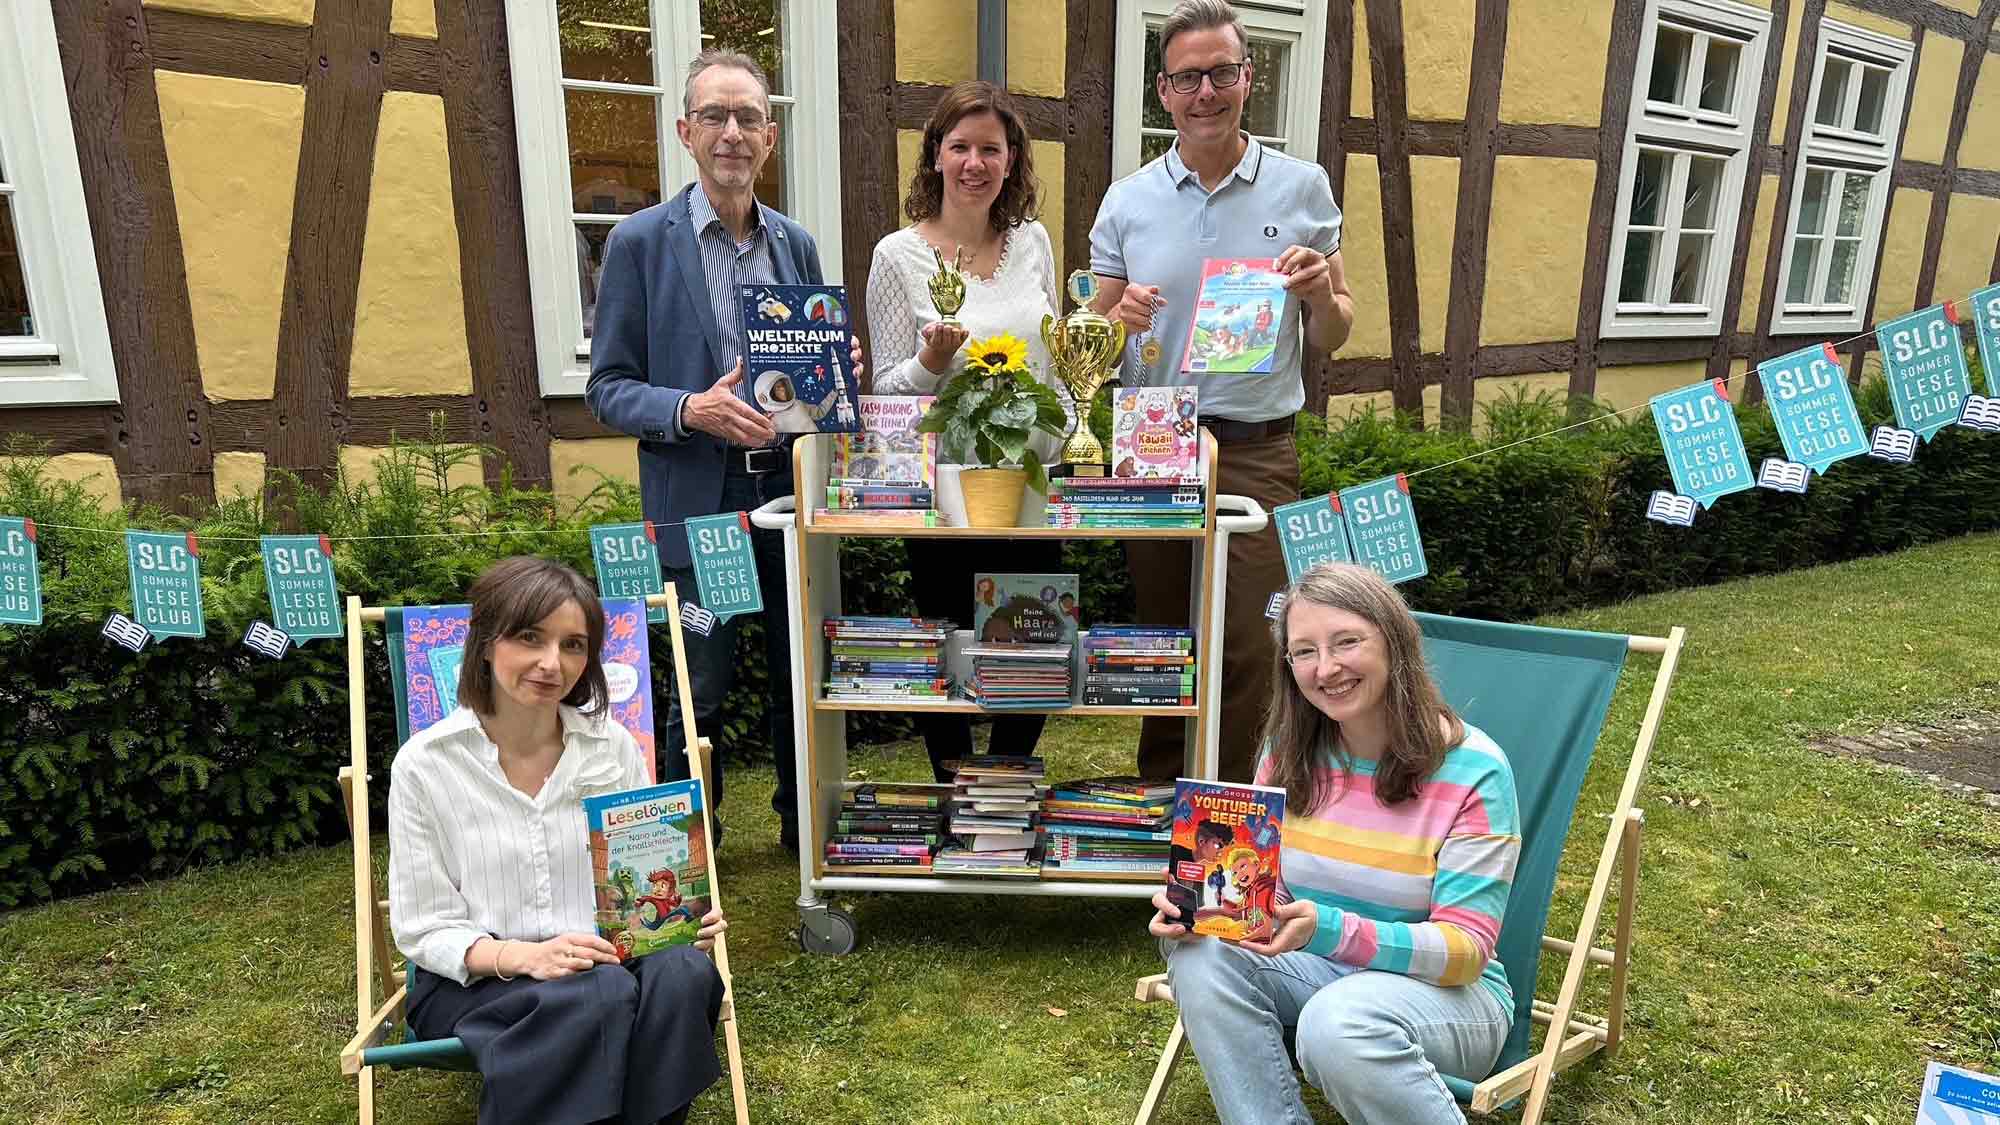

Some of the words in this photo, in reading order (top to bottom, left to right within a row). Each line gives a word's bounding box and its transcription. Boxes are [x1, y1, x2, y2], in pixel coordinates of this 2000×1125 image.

[747, 329, 845, 342] WELTRAUM
[1893, 319, 1948, 363] SLC
[750, 343, 823, 354] PROJEKTE
[1901, 354, 1951, 380] SOMMER
[1775, 359, 1832, 400] SLC
[1904, 369, 1956, 401] LESE
[860, 403, 880, 415] EASY
[1666, 394, 1721, 433] SLC
[1787, 392, 1838, 417] SOMMER
[1909, 391, 1960, 422] CLUB
[1792, 407, 1847, 436] LESE
[1138, 432, 1173, 444] Kawaii
[1676, 427, 1726, 449] SOMMER
[1799, 427, 1851, 457] CLUB
[1682, 441, 1732, 469] LESE
[1687, 462, 1737, 490] CLUB
[1174, 495, 1198, 503] TOPP
[1354, 489, 1401, 524] SLC
[1287, 509, 1333, 542] SLC
[1361, 521, 1406, 540] SOMMER
[602, 535, 648, 563] SLC
[698, 526, 742, 554] SLC
[1294, 538, 1337, 557] SOMMER
[1365, 533, 1409, 559] LESE
[138, 542, 187, 572] SLC
[274, 547, 322, 575] SLC
[704, 556, 745, 569] SOMMER
[1369, 552, 1413, 575] CLUB
[142, 575, 188, 588] SOMMER
[608, 566, 649, 578] SOMMER
[707, 569, 748, 588] LESE
[280, 580, 324, 590] SOMMER
[610, 578, 651, 596] LESE
[144, 588, 190, 607] LESE
[283, 592, 328, 609] LESE
[710, 587, 751, 606] CLUB
[147, 607, 192, 625] CLUB
[286, 611, 330, 628] CLUB
[1023, 608, 1043, 616] Meine
[1013, 615, 1056, 629] Haare
[607, 801, 686, 826] Leselöwen
[1194, 795, 1268, 817] YOUTUBER
[1209, 810, 1248, 827] BEEF
[652, 829, 667, 838] und
[611, 846, 624, 855] der
